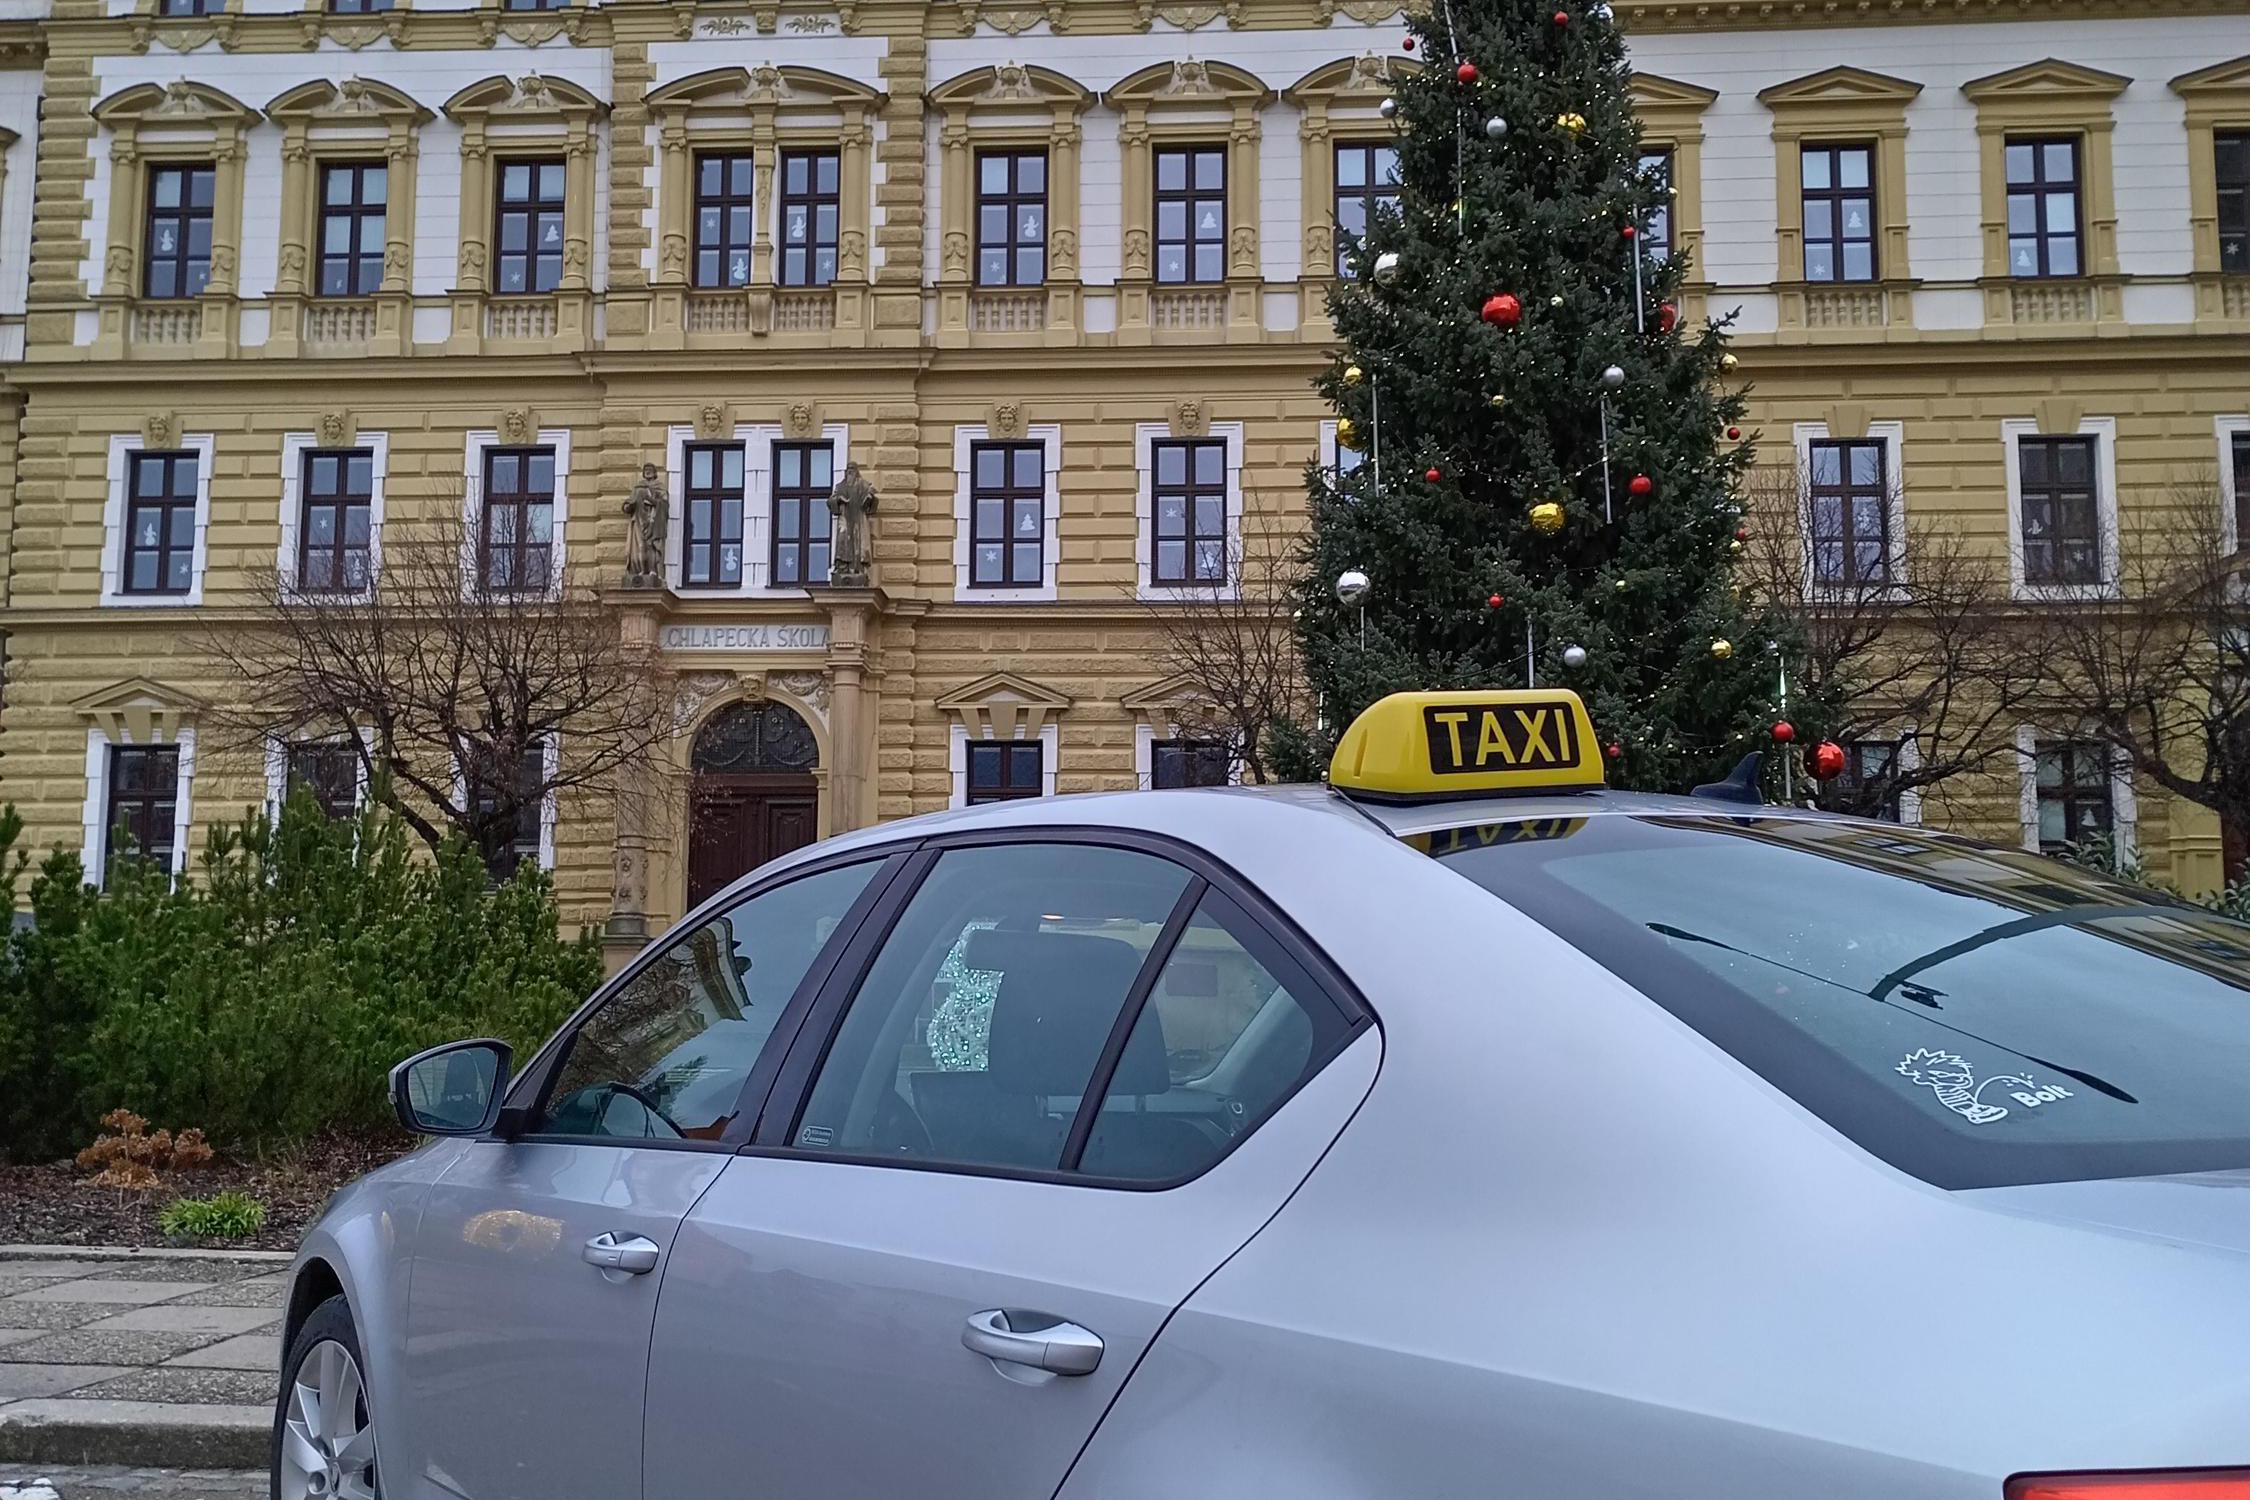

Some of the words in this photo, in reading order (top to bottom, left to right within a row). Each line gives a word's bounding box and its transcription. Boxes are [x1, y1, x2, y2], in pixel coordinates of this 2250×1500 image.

[667, 625, 770, 647] CHLAPECKÁ
[777, 625, 832, 647] ŠKOLA
[1434, 709, 1570, 766] TAXI
[2009, 1085, 2074, 1107] Bolt
